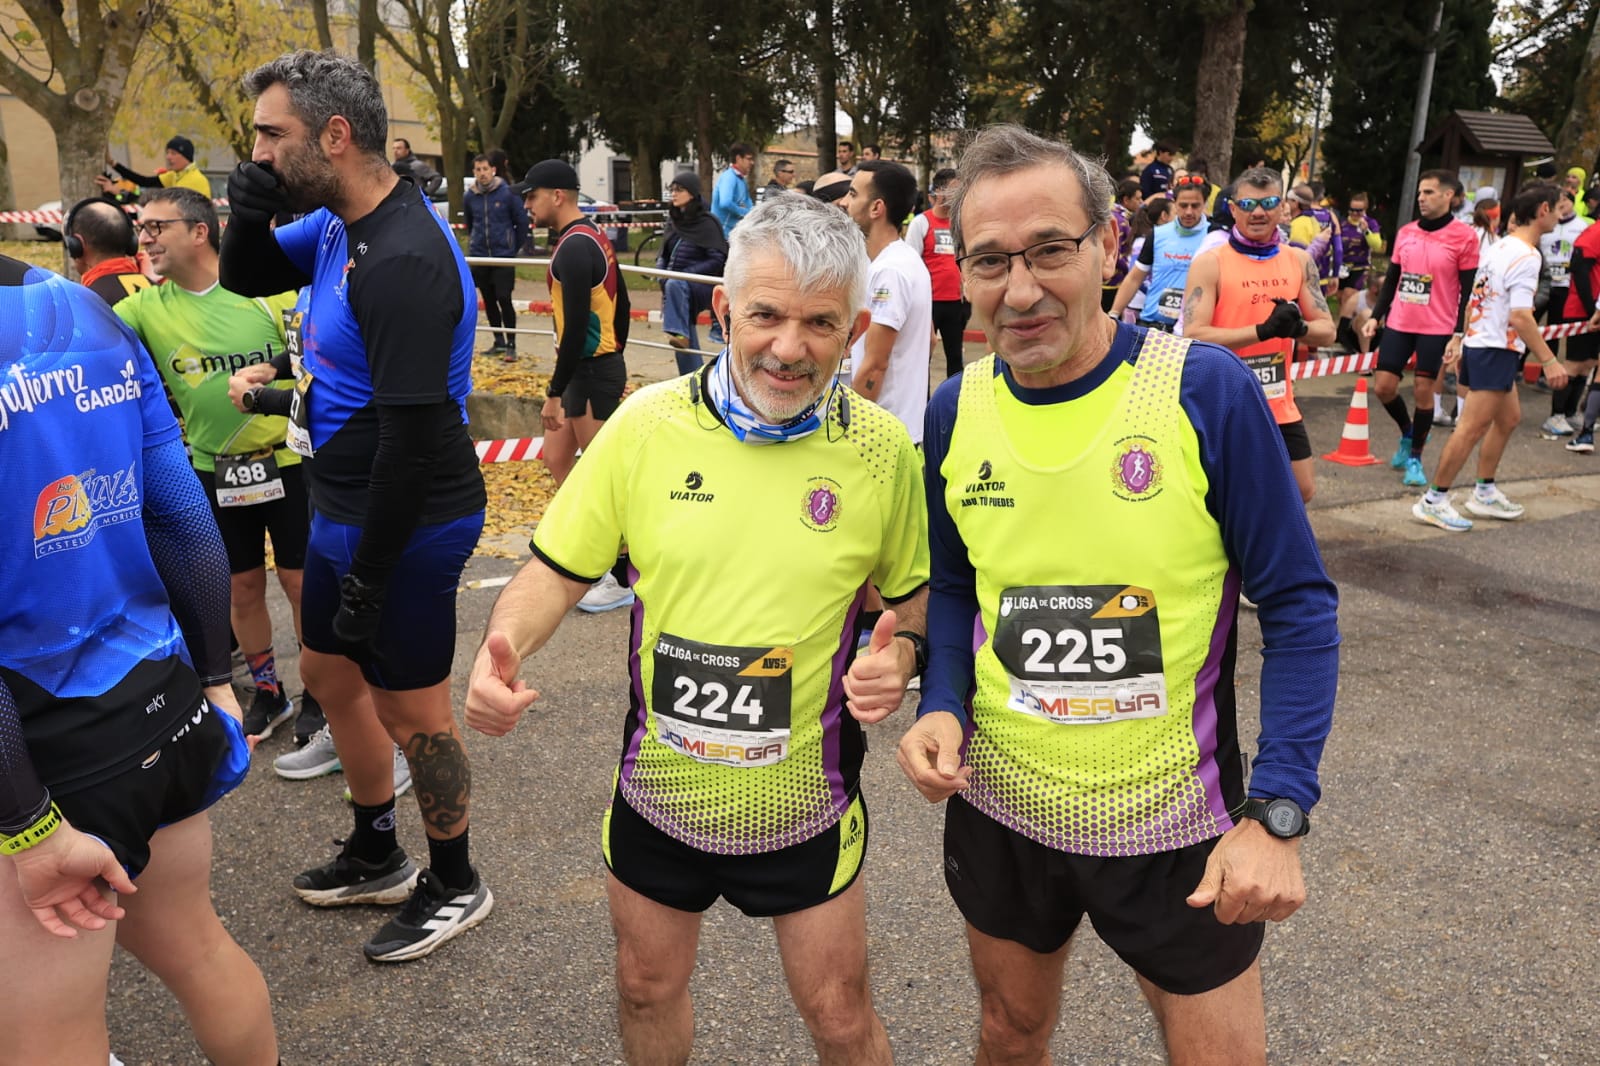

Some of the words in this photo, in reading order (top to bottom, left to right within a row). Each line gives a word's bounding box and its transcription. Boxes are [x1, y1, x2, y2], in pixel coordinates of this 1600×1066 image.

[1402, 280, 1425, 293] 240
[172, 343, 273, 377] campal
[75, 380, 142, 413] GARDEN
[225, 462, 267, 486] 498
[669, 490, 715, 503] VIATOR
[965, 481, 1006, 493] VIATOR
[1014, 596, 1039, 609] LIGA
[1039, 599, 1049, 607] DE
[1049, 596, 1093, 610] CROSS
[669, 645, 693, 662] LIGA
[701, 652, 741, 668] CROSS
[762, 657, 781, 669] AVS
[1021, 628, 1127, 674] 225
[673, 675, 764, 726] 224
[1015, 689, 1161, 717] JOMISAGA
[661, 728, 782, 761] JOMISAGA
